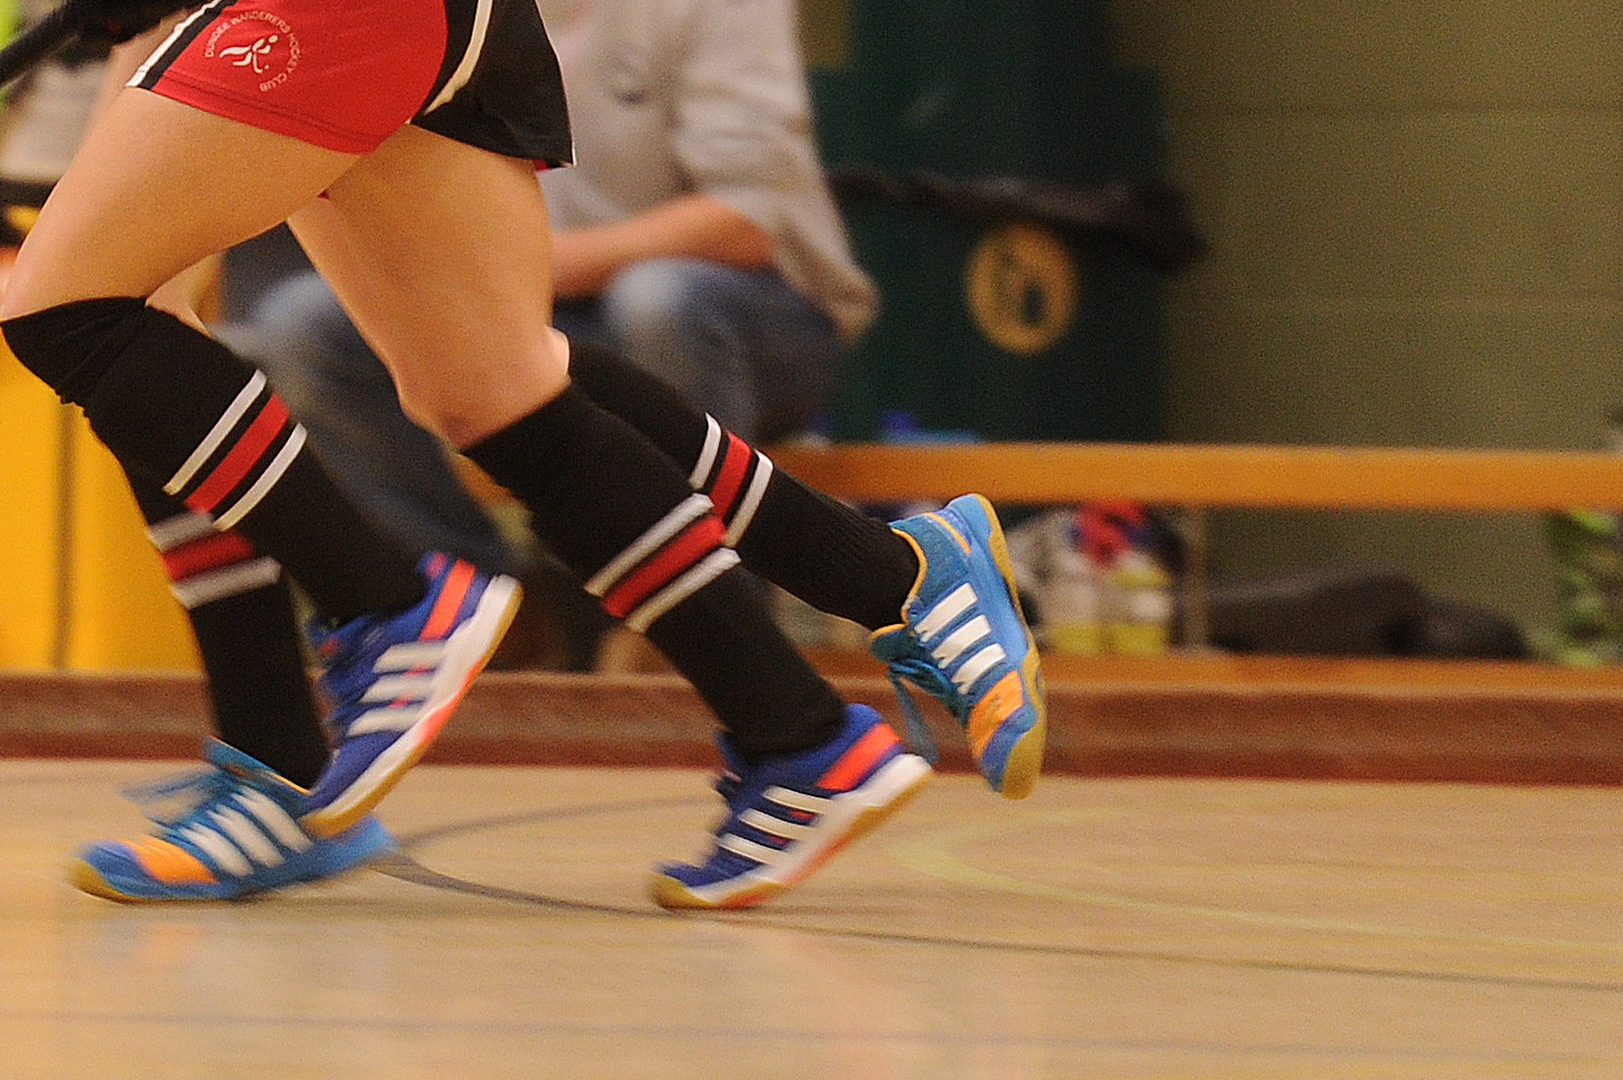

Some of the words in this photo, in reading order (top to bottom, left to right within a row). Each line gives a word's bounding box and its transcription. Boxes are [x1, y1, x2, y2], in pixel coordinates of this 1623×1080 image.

[230, 10, 292, 34] WANDERERS
[286, 32, 301, 74] HOCKEY
[259, 72, 288, 92] CLUB
